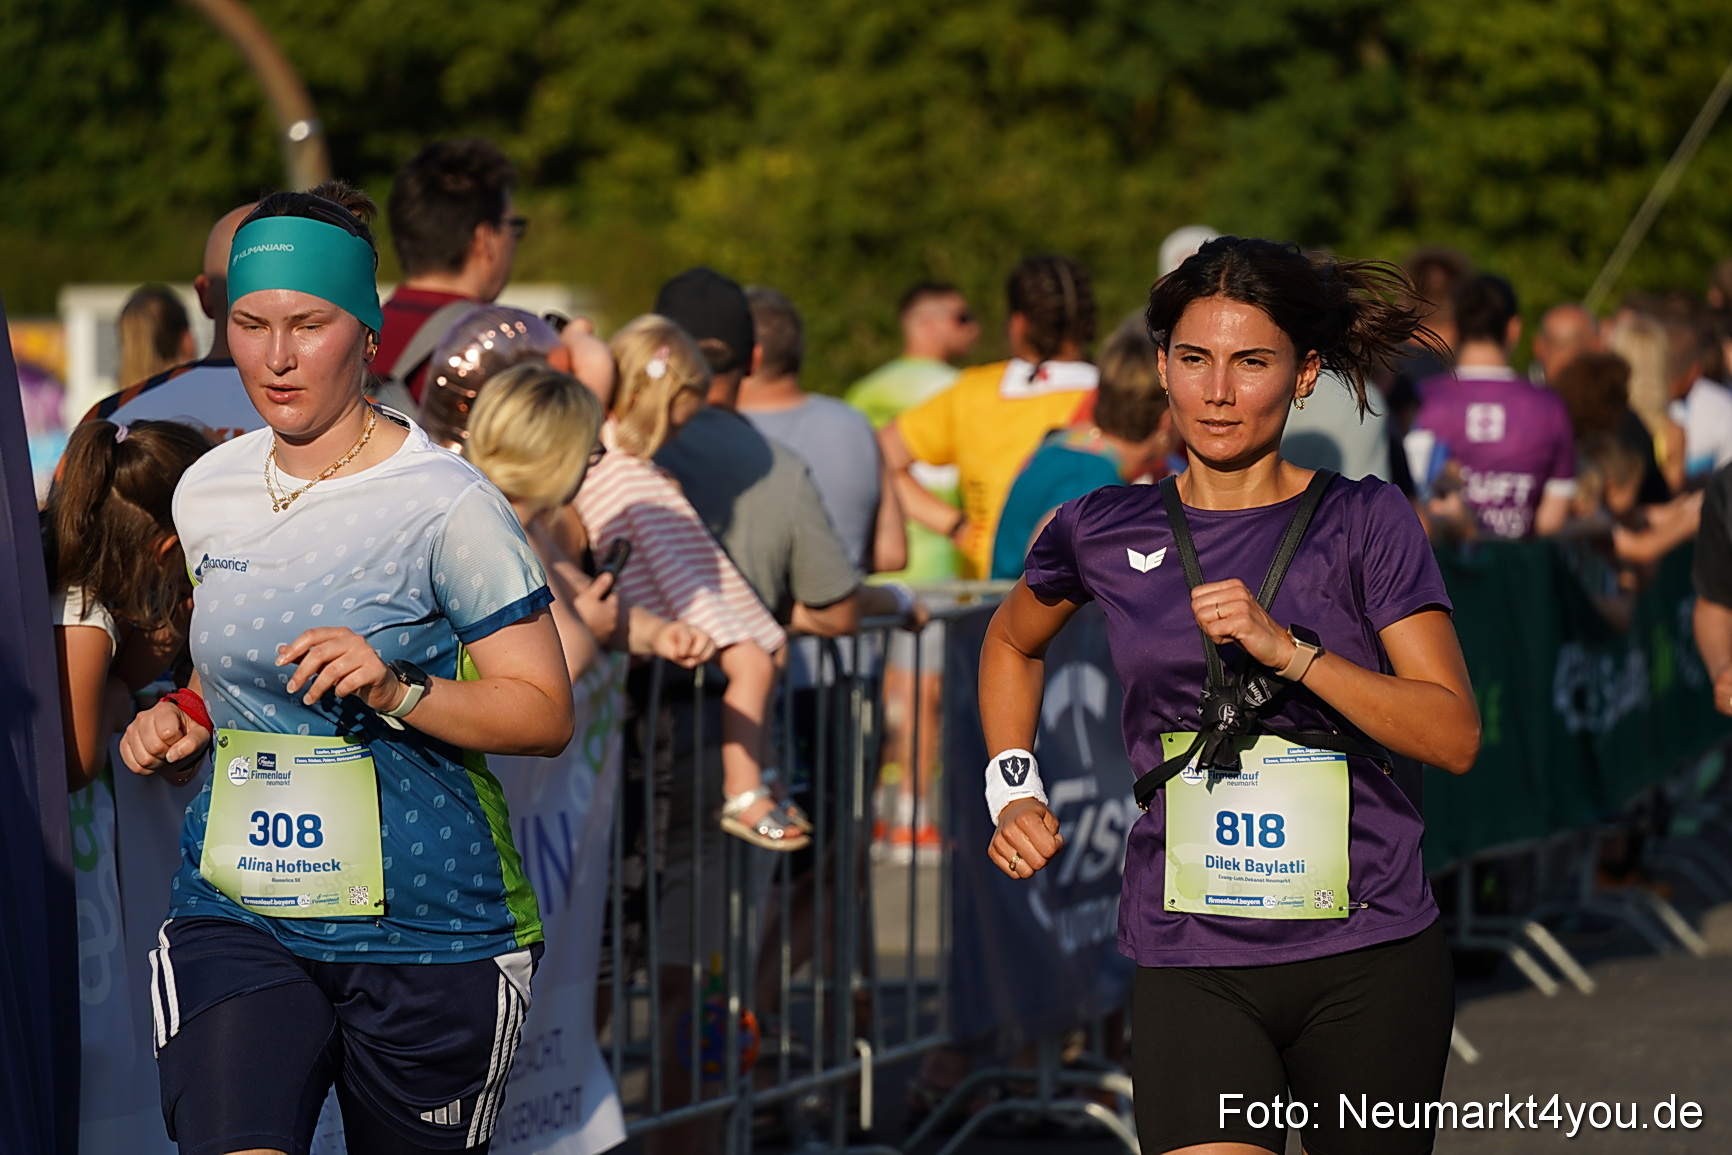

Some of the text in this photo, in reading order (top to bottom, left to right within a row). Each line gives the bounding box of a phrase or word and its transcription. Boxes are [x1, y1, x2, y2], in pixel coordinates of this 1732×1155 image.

[239, 244, 294, 259] KILIMANJARO
[251, 770, 291, 780] Firmenlauf
[1208, 770, 1259, 780] Firmenlauf
[249, 810, 323, 848] 308
[1216, 811, 1285, 848] 818
[237, 856, 341, 872] Alina Hofbeck
[1205, 855, 1305, 876] Dilek Baylatli
[244, 898, 295, 906] firmenlauf.bayern
[1208, 896, 1260, 906] firmenlauf.bayern
